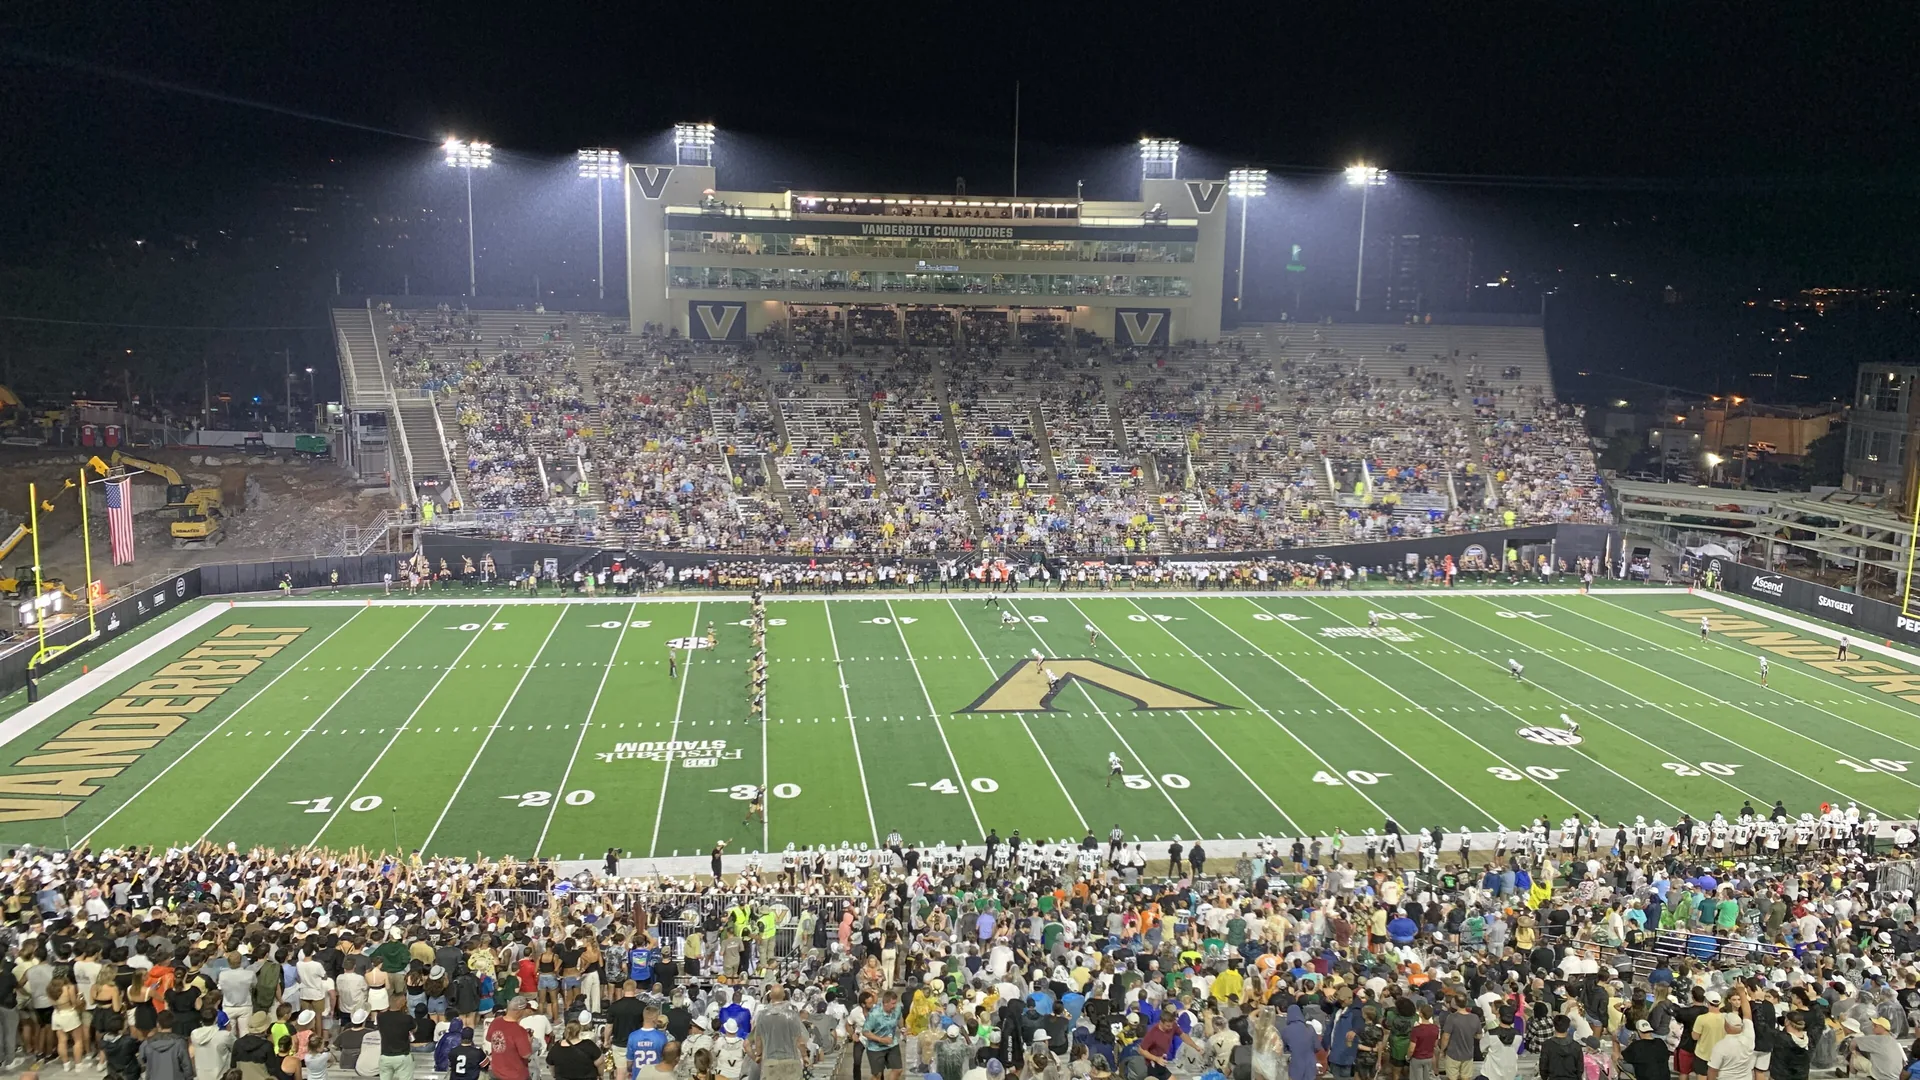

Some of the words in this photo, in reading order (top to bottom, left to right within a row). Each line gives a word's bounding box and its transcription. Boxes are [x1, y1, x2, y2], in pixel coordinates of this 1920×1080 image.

[630, 166, 674, 200] V
[1184, 181, 1227, 214] V
[861, 224, 931, 236] VANDERBILT
[934, 226, 1013, 238] COMMODORES
[696, 305, 742, 340] V
[1119, 312, 1164, 346] V
[1752, 576, 1783, 593] Ascend
[1818, 595, 1854, 615] SEATGEEK
[1656, 607, 1920, 705] VANDER
[0, 624, 311, 823] VANDERBILT
[614, 740, 727, 752] STADIUM
[594, 748, 744, 763] FirstBank
[1486, 766, 1559, 781] 30
[1661, 761, 1735, 777] 20
[1835, 757, 1908, 773] 10
[930, 777, 999, 794] 40
[1123, 774, 1191, 790] 50
[1312, 770, 1379, 786] 40
[518, 789, 595, 807] 20
[729, 783, 801, 801] 30
[304, 795, 382, 813] 10
[456, 1054, 466, 1074] 2
[635, 1050, 657, 1068] 22
